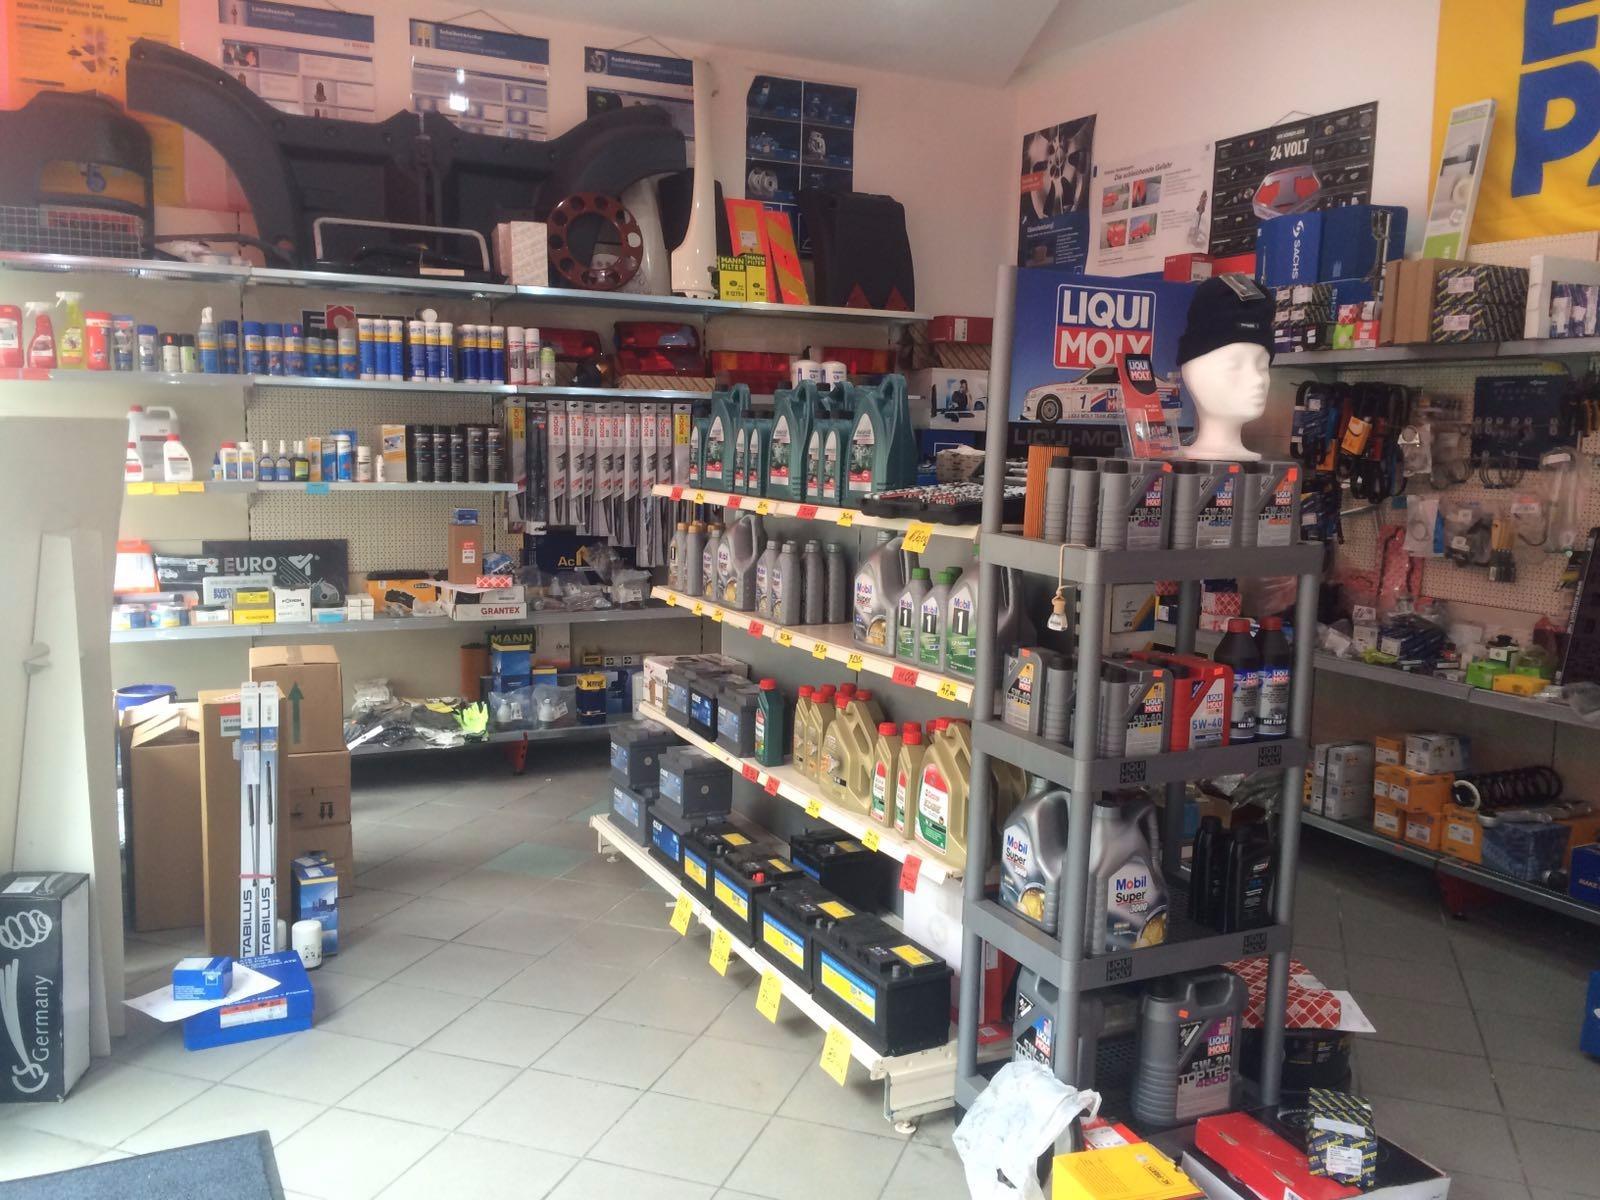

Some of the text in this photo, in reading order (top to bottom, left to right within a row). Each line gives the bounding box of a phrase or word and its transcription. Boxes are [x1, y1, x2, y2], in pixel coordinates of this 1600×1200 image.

[1511, 61, 1600, 198] P
[1270, 138, 1310, 161] 24 VOLT
[720, 256, 745, 264] MANN
[1292, 239, 1300, 280] SACHS
[720, 263, 745, 271] FILTER
[1062, 290, 1150, 329] LIQUI
[1060, 330, 1150, 366] MOLY
[1129, 361, 1148, 370] LIQUI
[1130, 370, 1151, 380] MOLY
[1080, 394, 1086, 409] 1
[1216, 498, 1232, 506] MOLY
[1135, 507, 1161, 515] 5W-30
[1265, 506, 1290, 514] 5W-30
[224, 556, 277, 572] EURO
[857, 583, 872, 594] Mobil
[900, 599, 912, 608] Mobil
[923, 604, 937, 613] Mobil
[954, 597, 970, 609] Mobil
[481, 607, 520, 615] GRANTEX
[903, 609, 908, 626] 1
[957, 611, 963, 633] 1
[927, 615, 932, 632] 1
[490, 633, 533, 642] MANN
[1145, 705, 1161, 713] MOLY
[1208, 701, 1223, 709] MOLY
[1133, 714, 1161, 723] 5W-40
[1192, 718, 1222, 730] 5W-40
[1259, 746, 1281, 757] LIQUI
[1258, 756, 1280, 767] MOLY
[1122, 762, 1145, 773] LIQUI
[1121, 772, 1145, 783] MOLY
[1007, 836, 1028, 855] Mobil
[1006, 848, 1026, 865] Super
[1116, 876, 1147, 890] Mobil
[1116, 891, 1146, 903] Super
[1129, 903, 1147, 914] 3000
[243, 889, 252, 957] TABILUS
[261, 886, 271, 955] TABILUS
[1108, 959, 1131, 969] LIQUI
[1107, 968, 1131, 979] MOLY
[32, 975, 53, 1061] Germany
[1208, 1036, 1229, 1045] LIQUI
[1208, 1045, 1229, 1055] MOLY
[1192, 1055, 1230, 1071] 5W-30
[1179, 1065, 1230, 1085] TOP TEC
